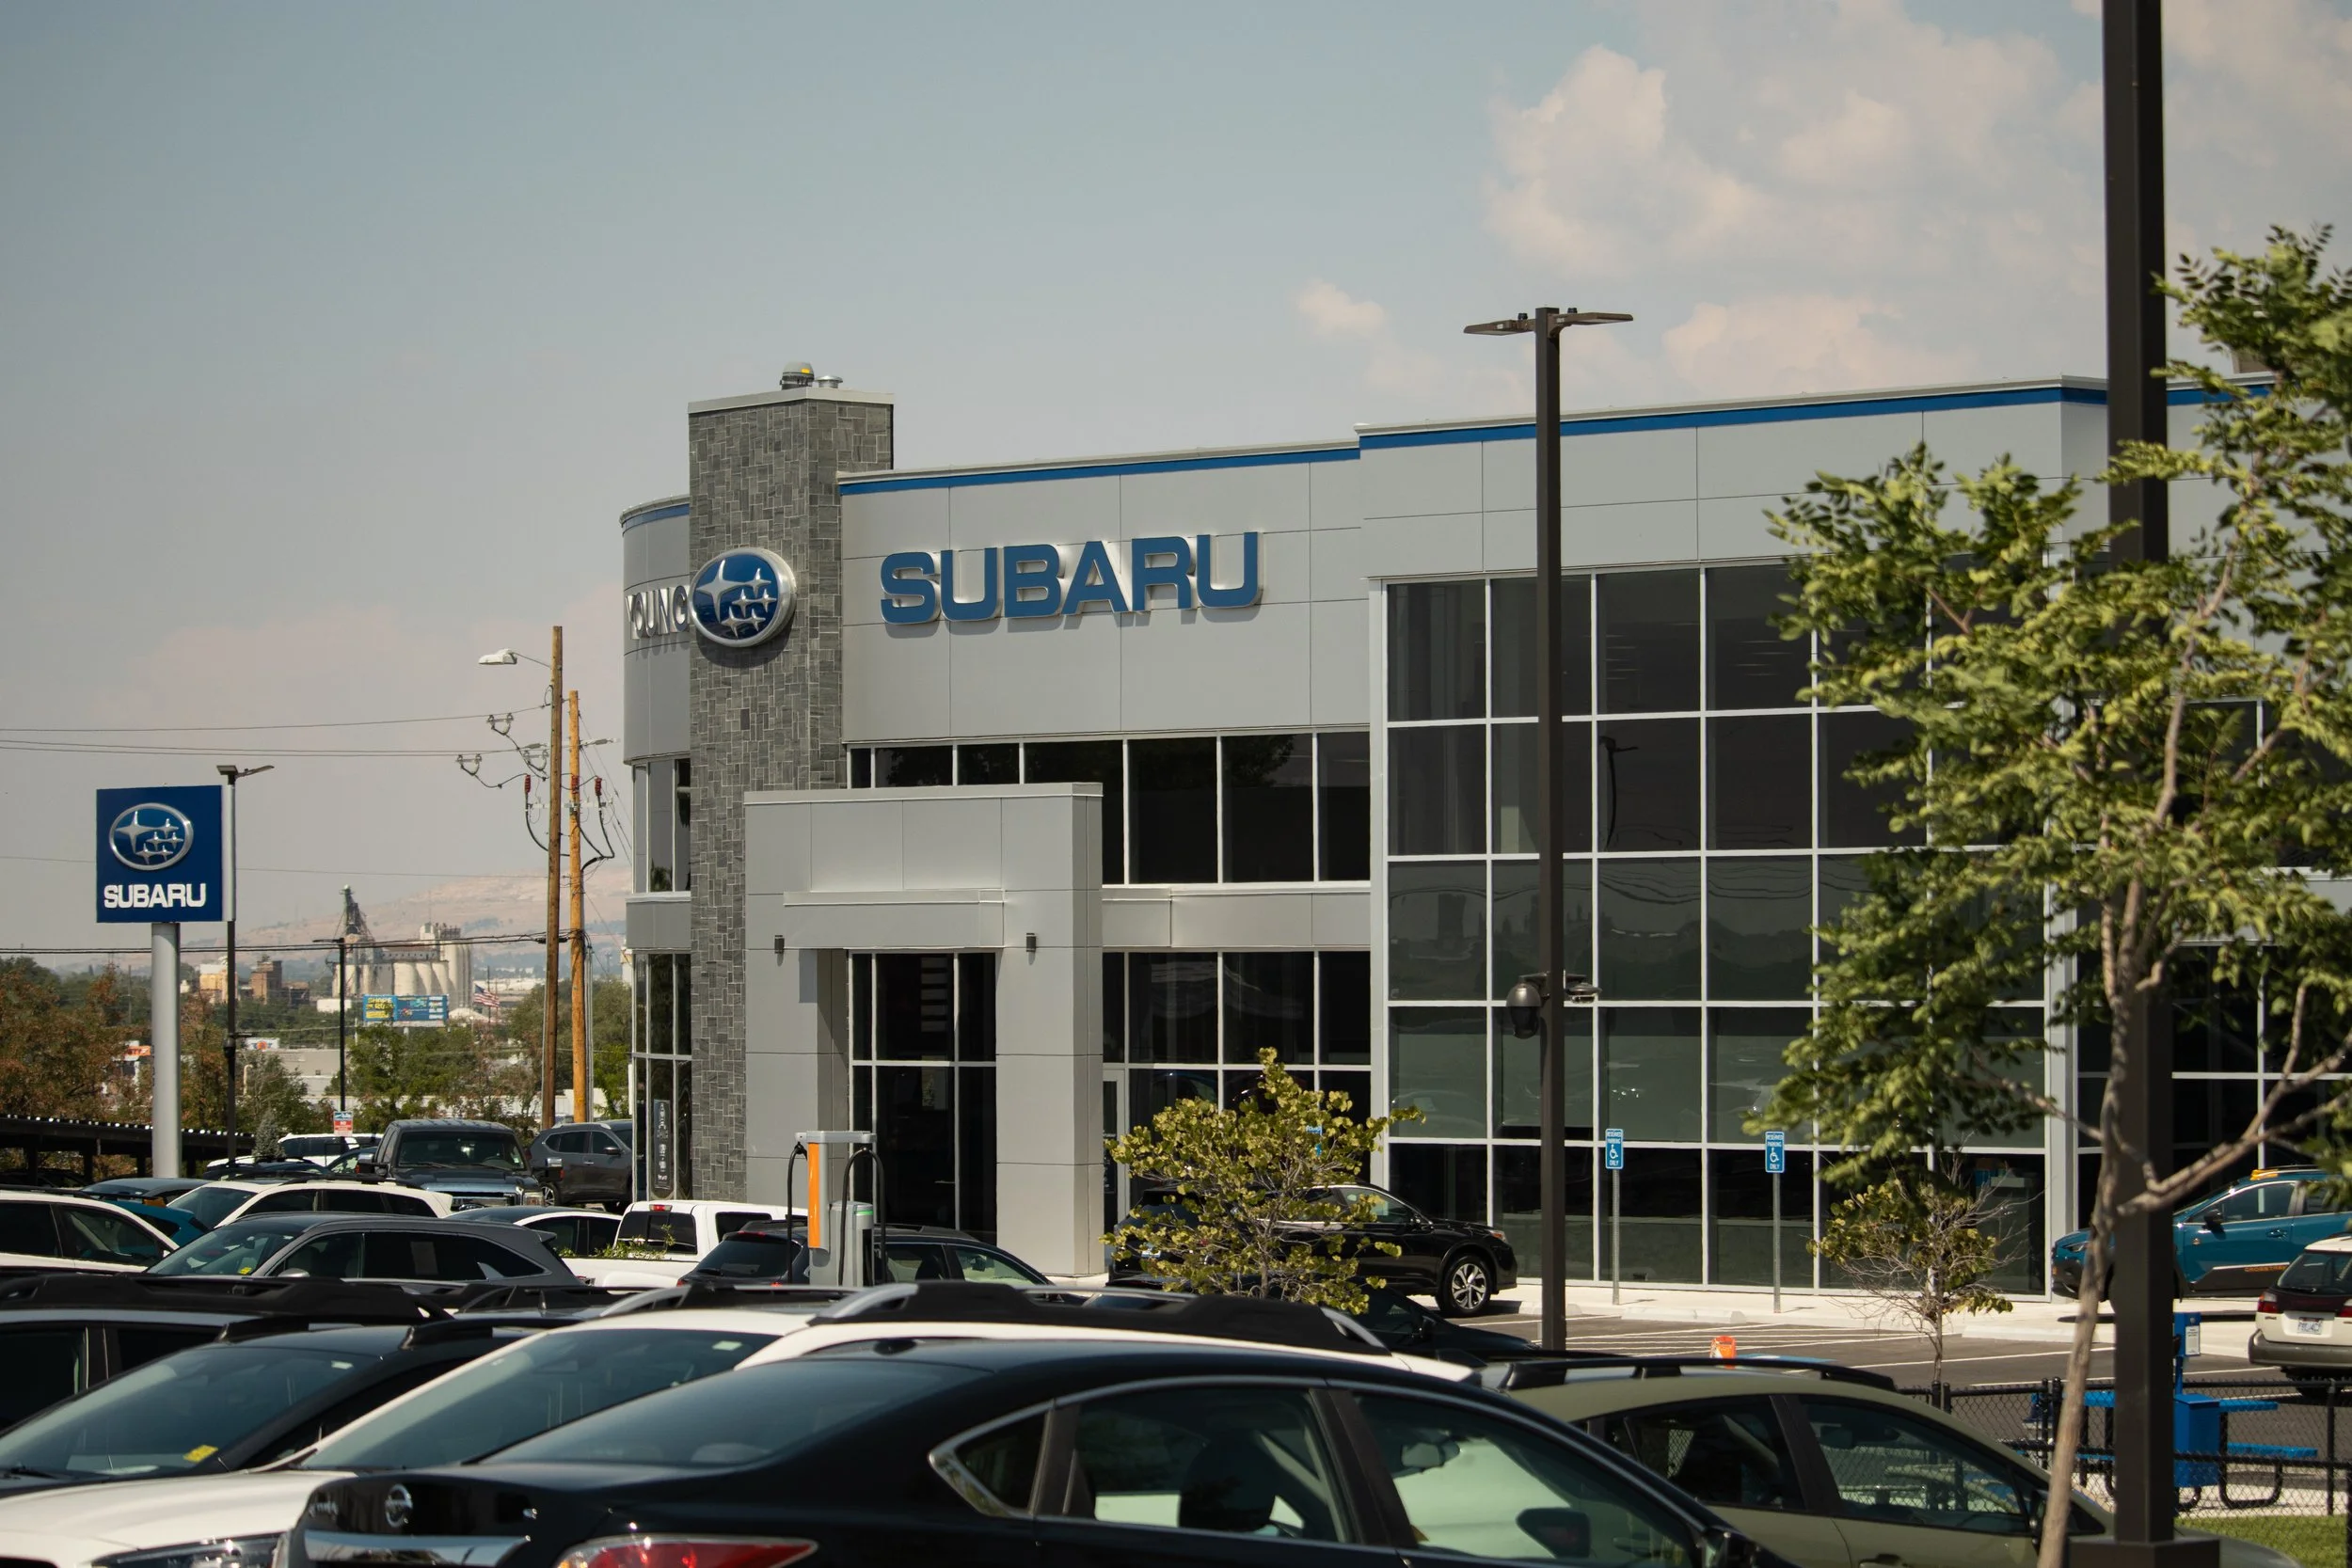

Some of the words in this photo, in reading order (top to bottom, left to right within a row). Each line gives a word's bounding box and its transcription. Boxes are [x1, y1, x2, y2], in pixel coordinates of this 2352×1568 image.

[881, 531, 1260, 624] SUBARU
[625, 585, 689, 639] YOUNG
[103, 882, 207, 909] SUBARU
